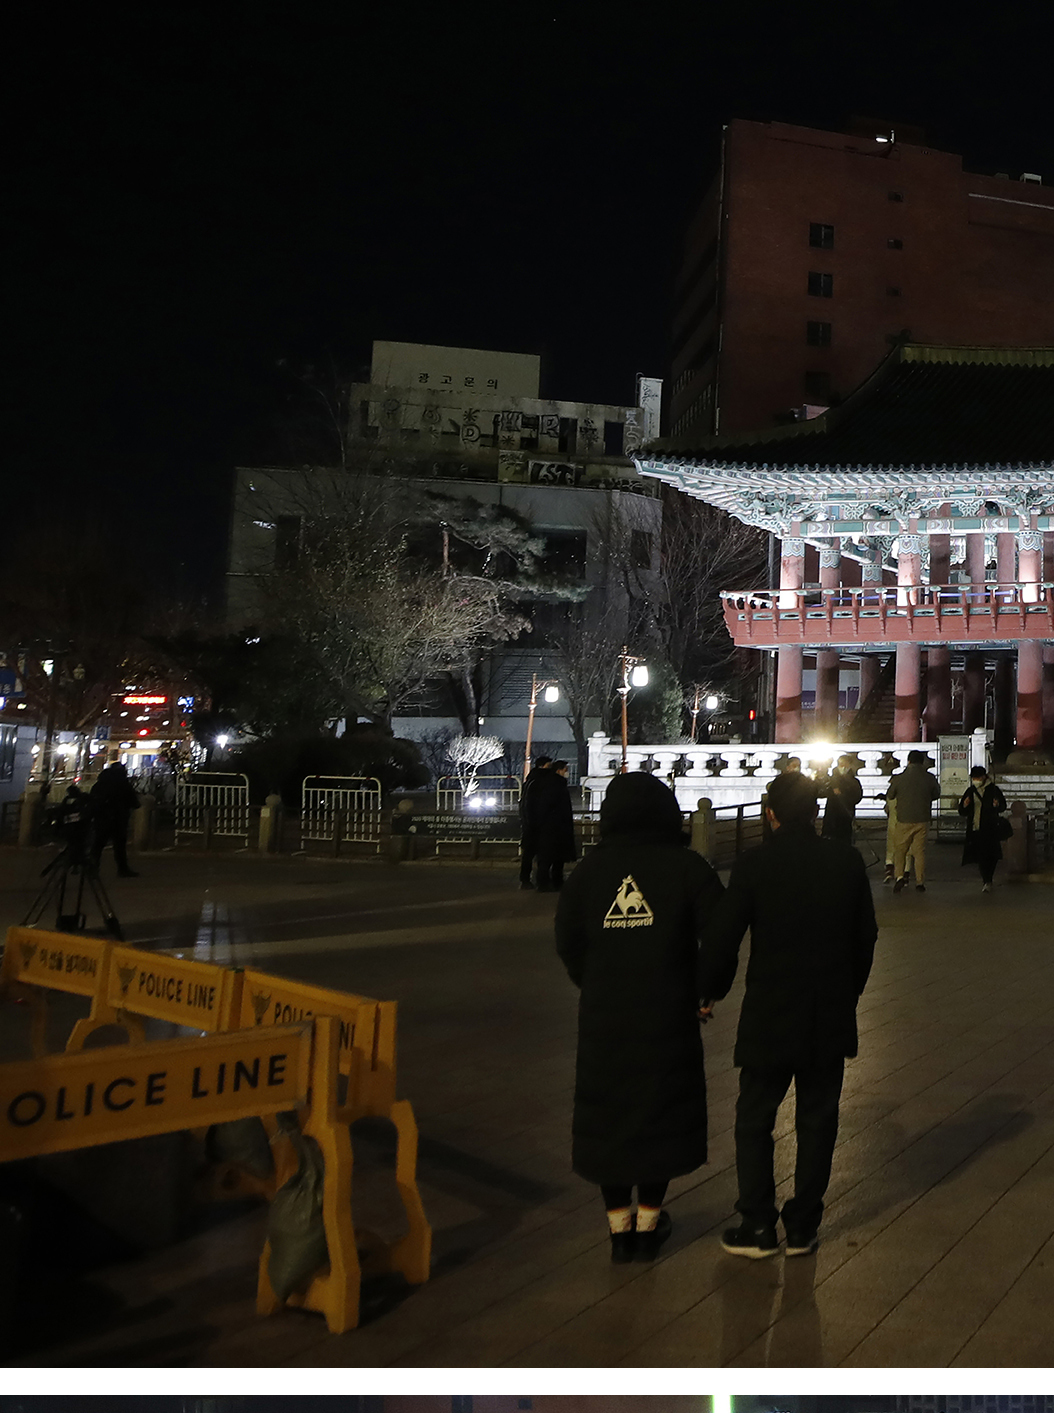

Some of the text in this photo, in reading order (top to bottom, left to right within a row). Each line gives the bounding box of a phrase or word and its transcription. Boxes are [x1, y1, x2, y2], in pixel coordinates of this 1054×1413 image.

[602, 918, 653, 929] le coq sportif
[138, 970, 216, 1011] POLICE LINE
[190, 1053, 289, 1100] LINE
